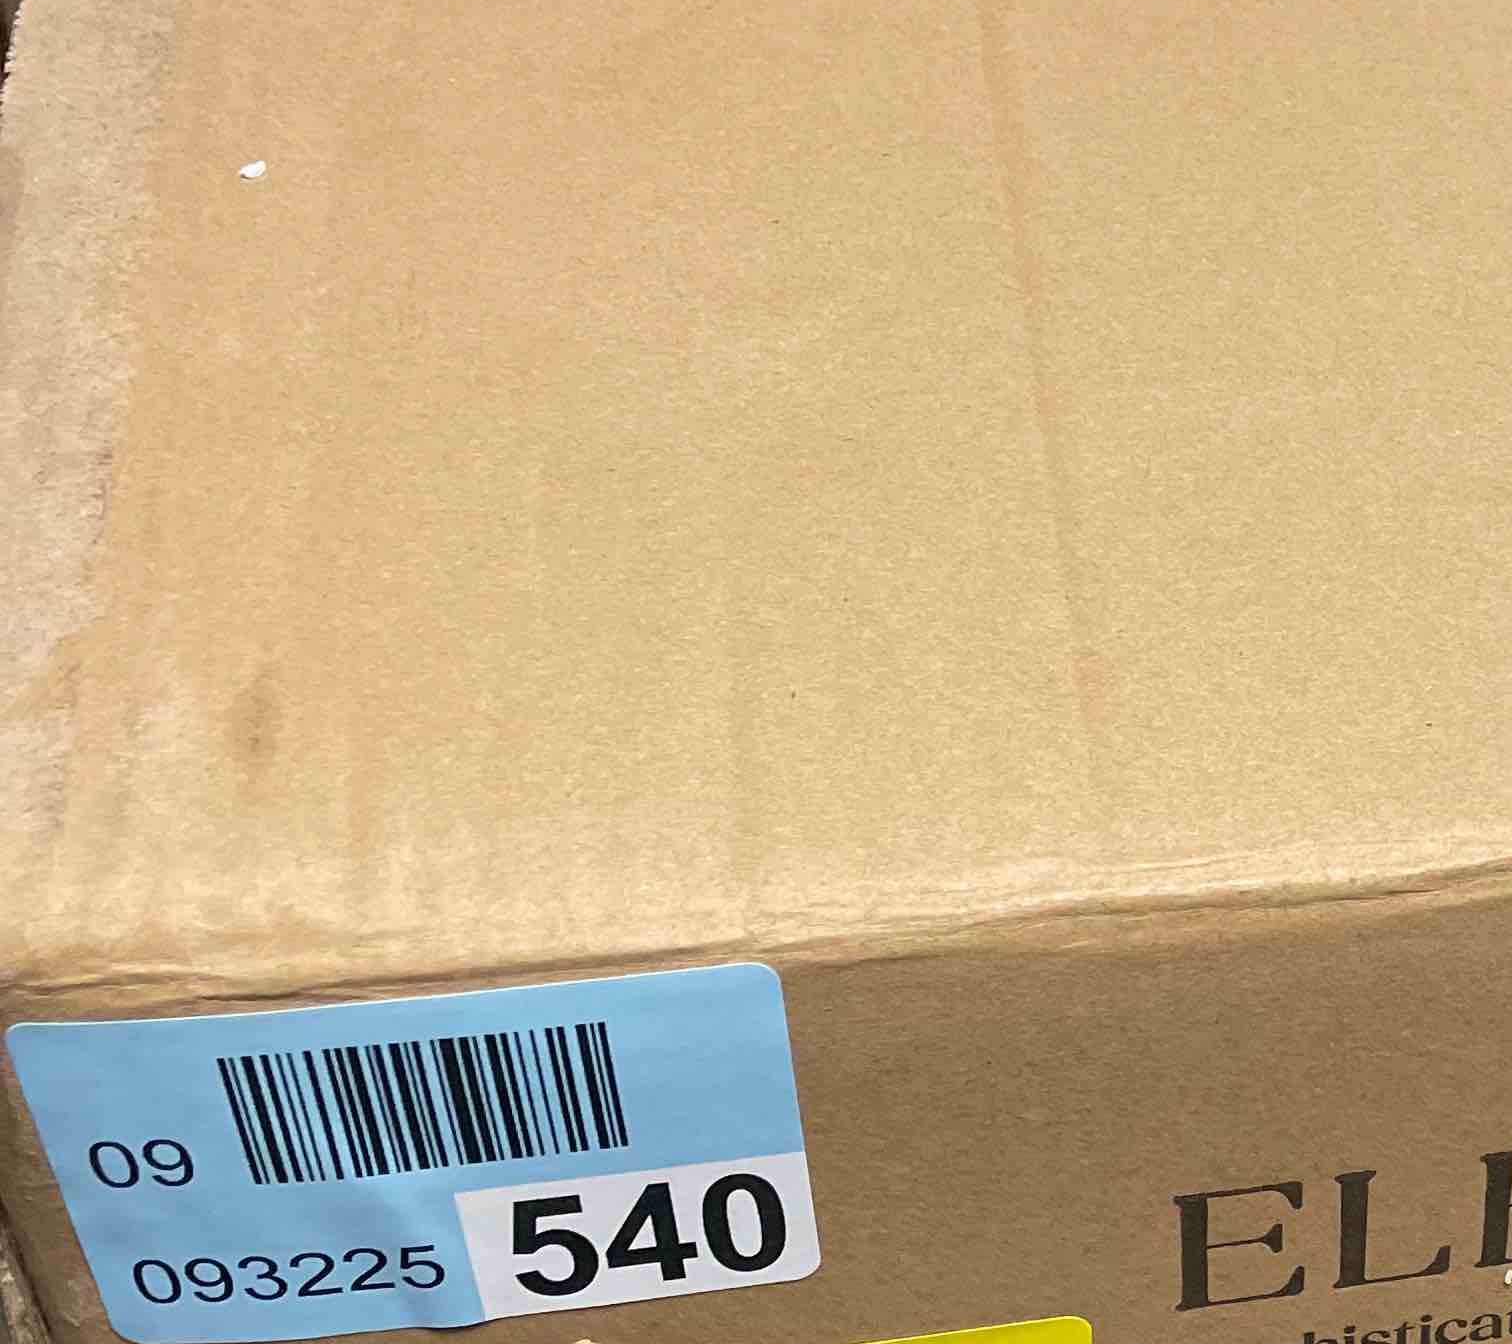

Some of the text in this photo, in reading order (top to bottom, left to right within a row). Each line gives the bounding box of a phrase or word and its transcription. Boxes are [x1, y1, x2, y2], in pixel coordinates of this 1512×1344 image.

[88, 1138, 194, 1190] 09
[511, 1172, 788, 1298] 540
[132, 1244, 447, 1307] 093225
